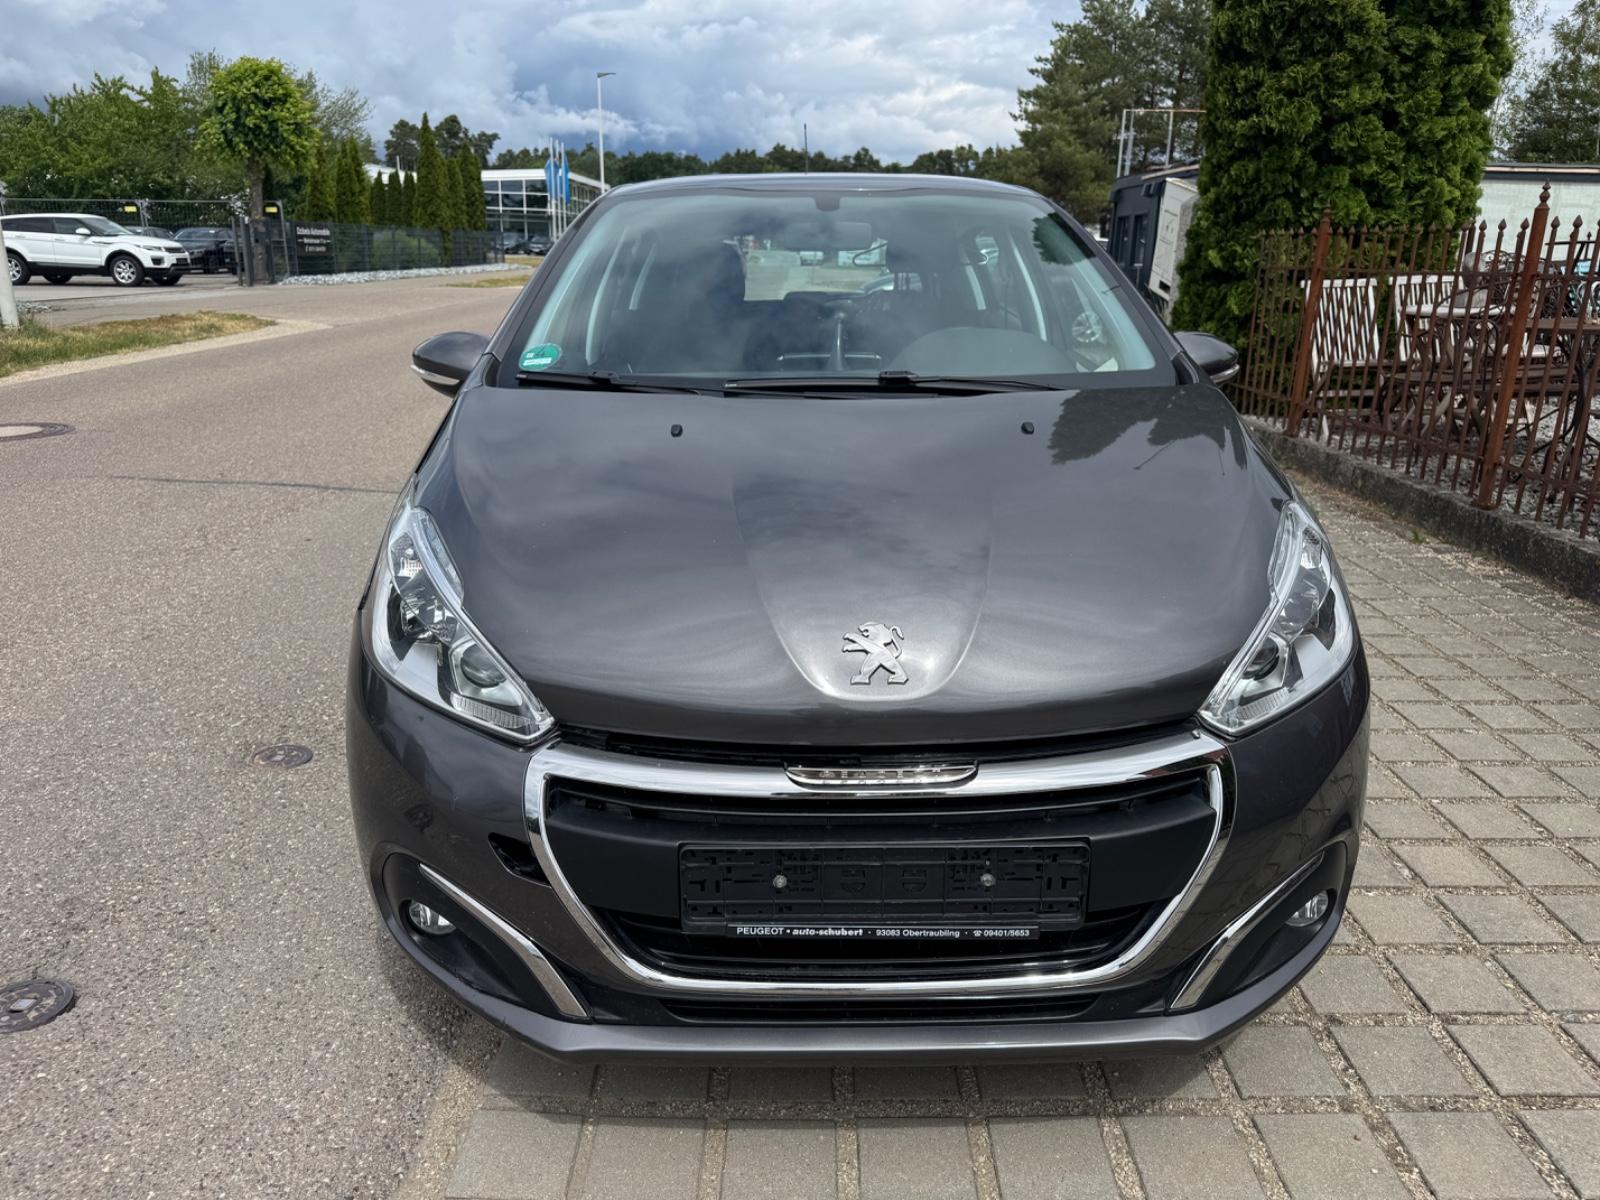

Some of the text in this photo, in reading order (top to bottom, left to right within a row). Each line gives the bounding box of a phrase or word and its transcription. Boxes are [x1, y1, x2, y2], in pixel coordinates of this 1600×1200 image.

[736, 927, 784, 935] PEUGEOT
[792, 928, 863, 936] auto-schubert
[903, 929, 960, 938] Obertraubling
